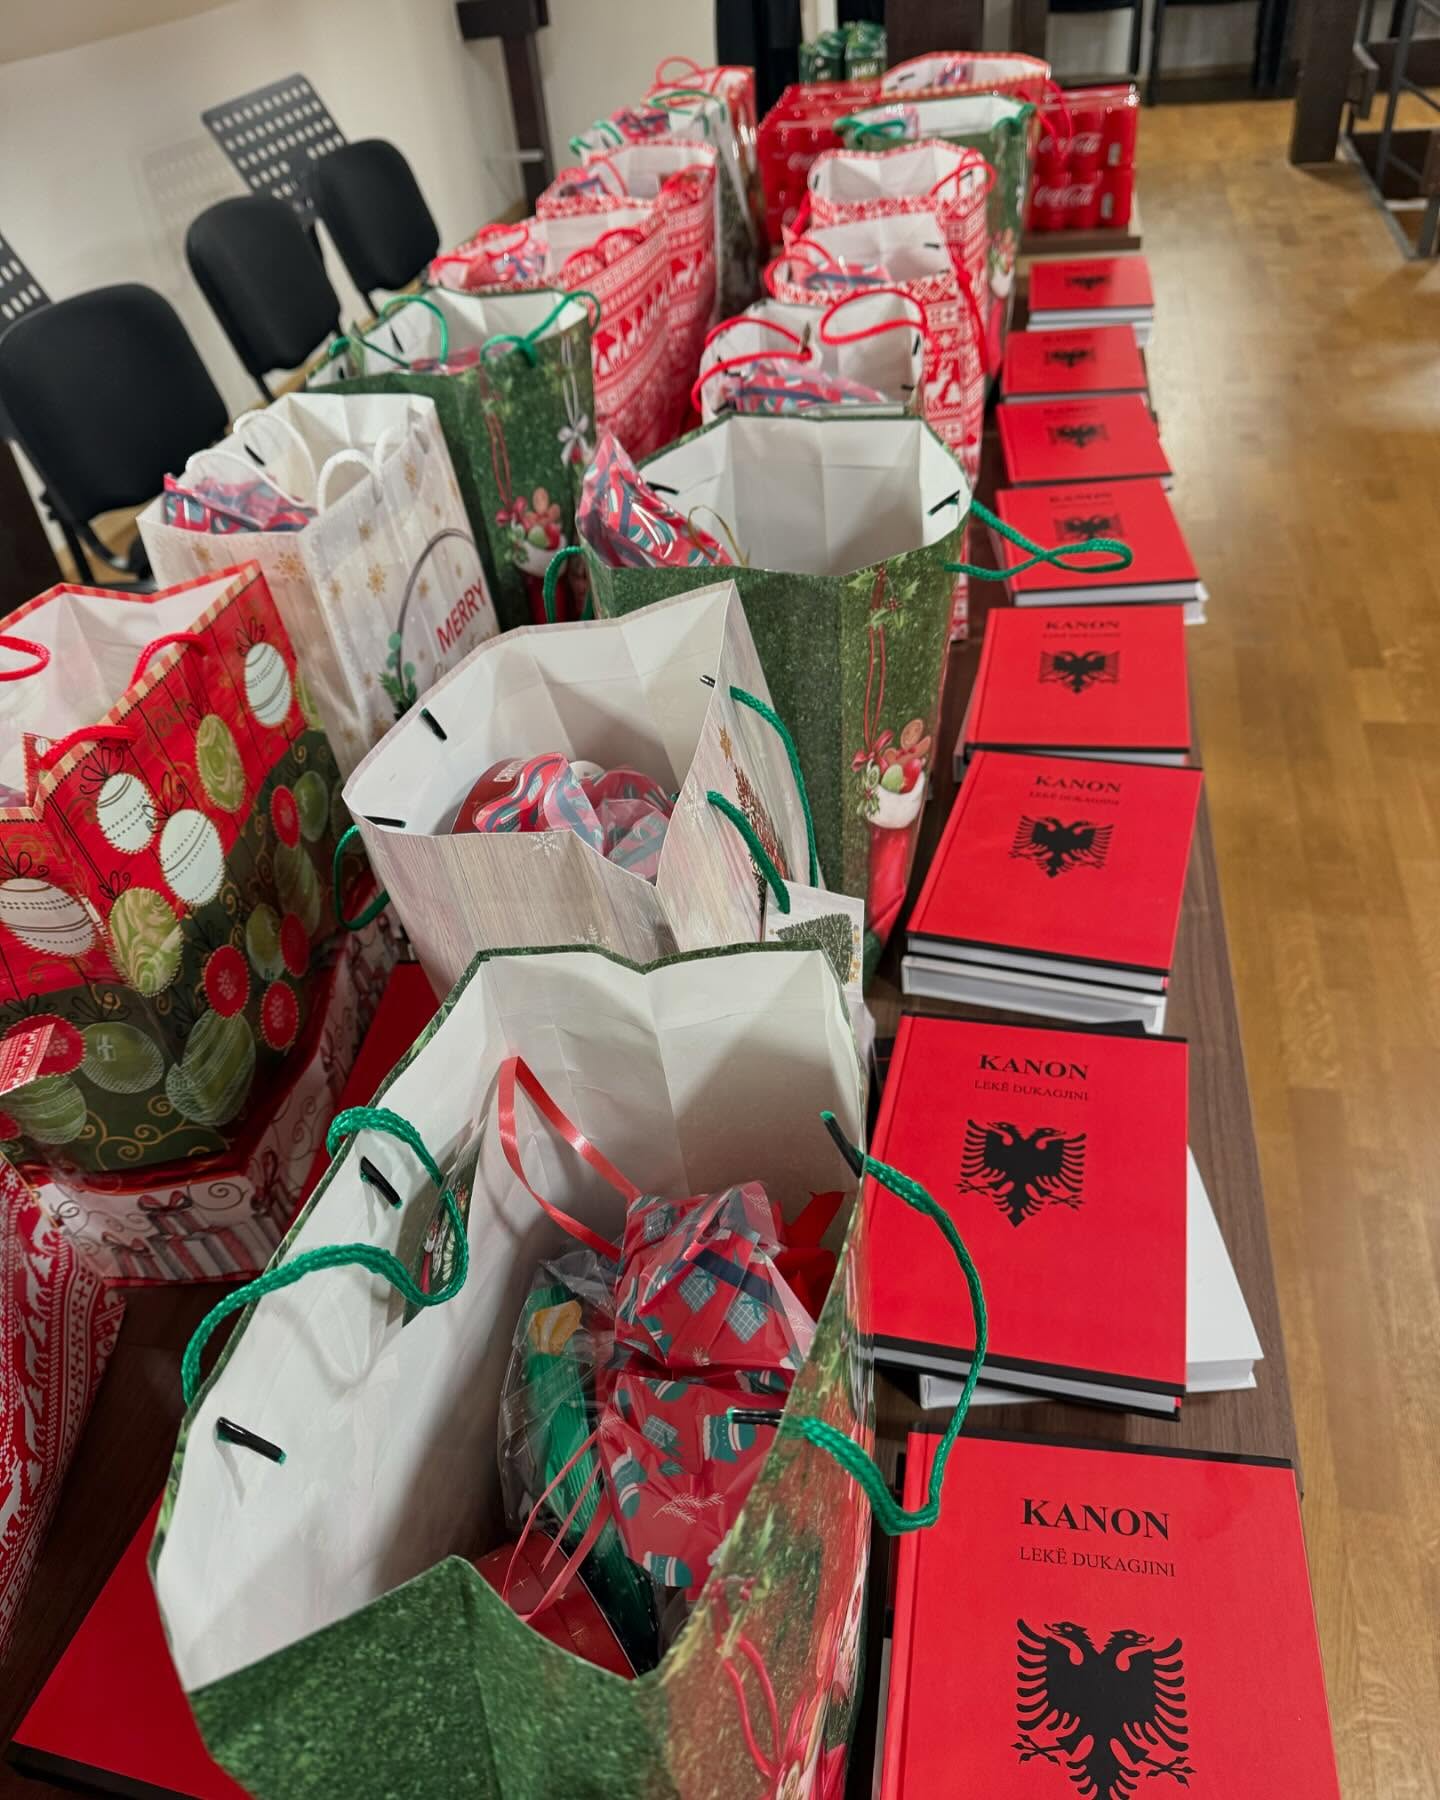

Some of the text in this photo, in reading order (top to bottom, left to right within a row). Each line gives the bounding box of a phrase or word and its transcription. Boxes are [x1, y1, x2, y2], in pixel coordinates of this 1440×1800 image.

[436, 576, 486, 654] MERRY
[1036, 775, 1121, 792] KANON
[979, 1054, 1089, 1080] KANON
[1012, 1083, 1088, 1101] DUKAGJINI
[1022, 1498, 1170, 1541] KANON
[1020, 1546, 1177, 1577] LEKË DUKAGJINI
